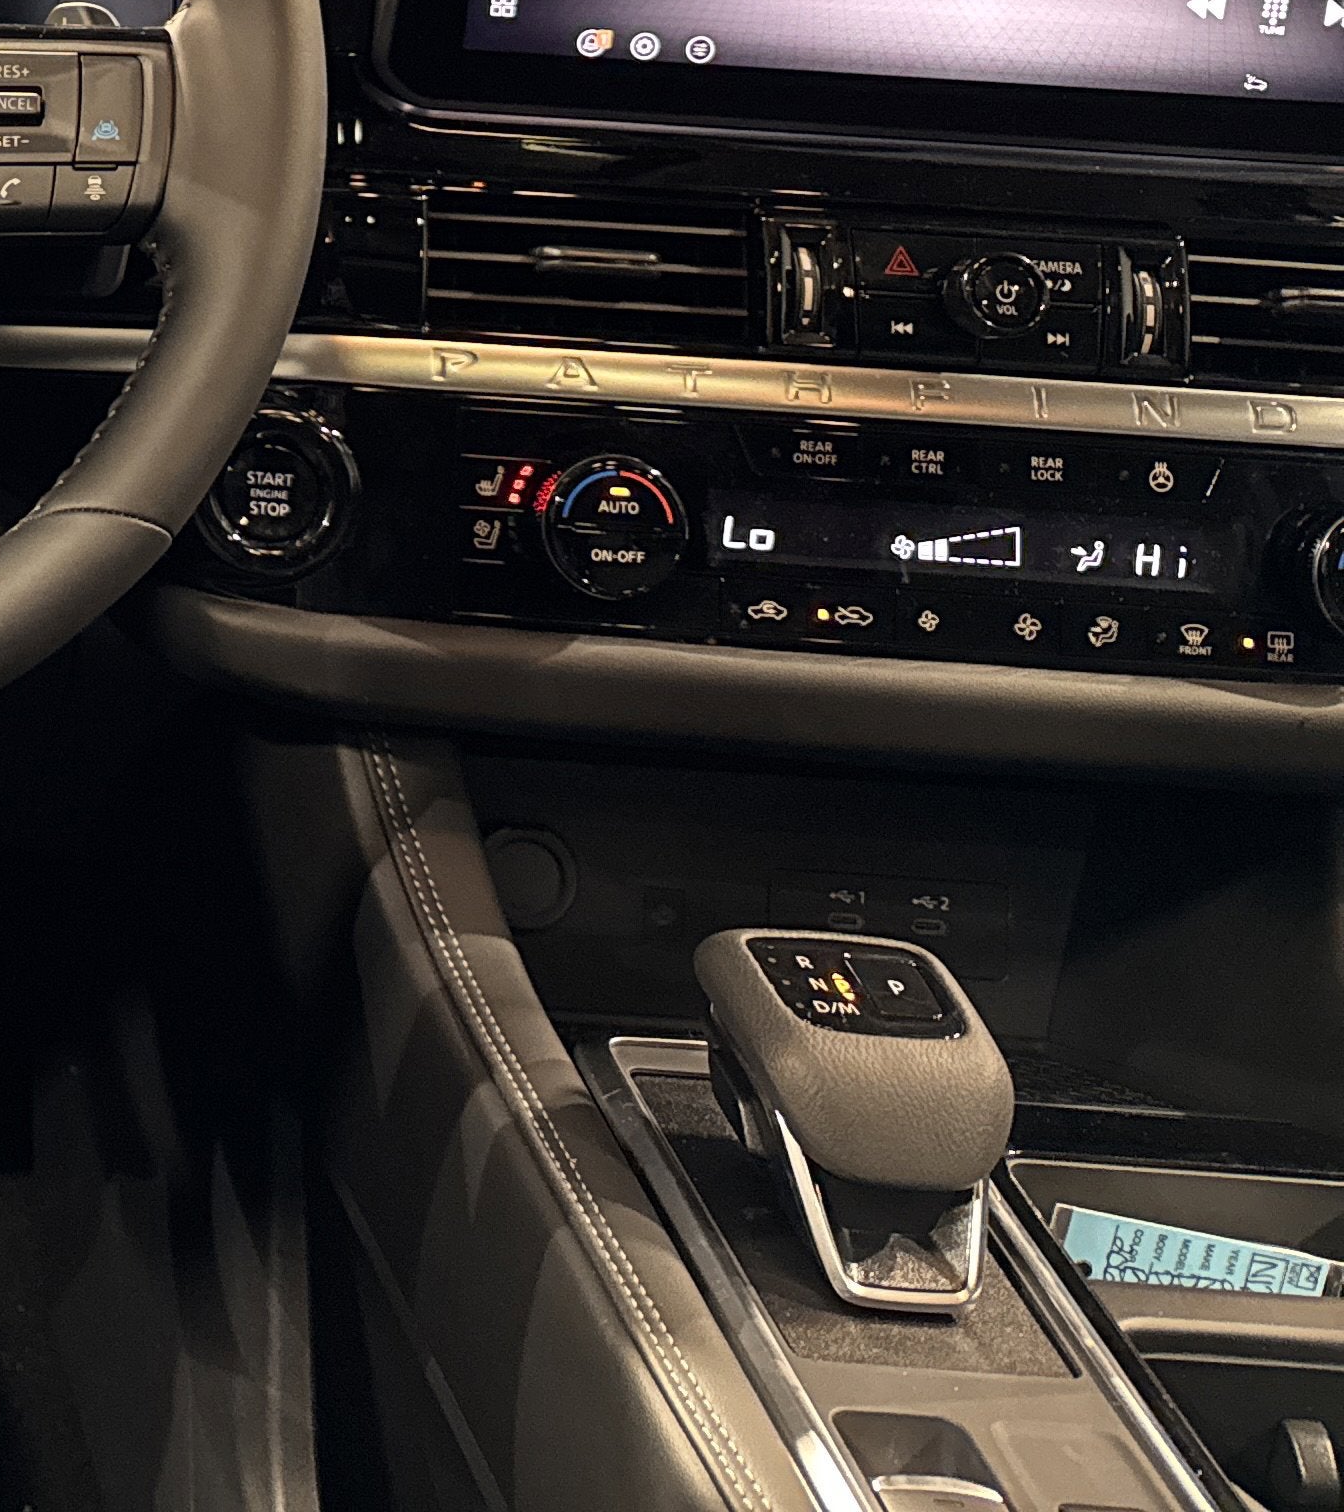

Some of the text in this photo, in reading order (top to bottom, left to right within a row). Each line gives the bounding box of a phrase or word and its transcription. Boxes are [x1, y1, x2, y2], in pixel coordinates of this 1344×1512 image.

[996, 304, 1019, 316] VOL
[799, 440, 833, 454] REAR
[911, 449, 945, 463] REAR
[1030, 456, 1064, 470] REAR
[911, 462, 944, 476] CTRL
[1030, 469, 1064, 482] LOCK
[246, 470, 294, 487] START
[249, 488, 289, 501] ENGINE
[249, 500, 292, 517] STOP
[597, 499, 640, 515] AUTO
[721, 515, 776, 551] Lo
[590, 548, 647, 564] ON-OFF
[1179, 646, 1212, 656] FRONT
[1267, 652, 1294, 663] REAR
[940, 897, 950, 912] 2
[795, 955, 815, 969] R
[808, 977, 829, 992] N
[886, 979, 905, 996] P
[812, 999, 861, 1016] D/M
[1127, 1229, 1144, 1264] COLOR
[1153, 1233, 1168, 1263] BODY
[1173, 1239, 1192, 1273] MODEL
[1199, 1243, 1216, 1272] MAKE
[1224, 1249, 1241, 1276] YEAR
